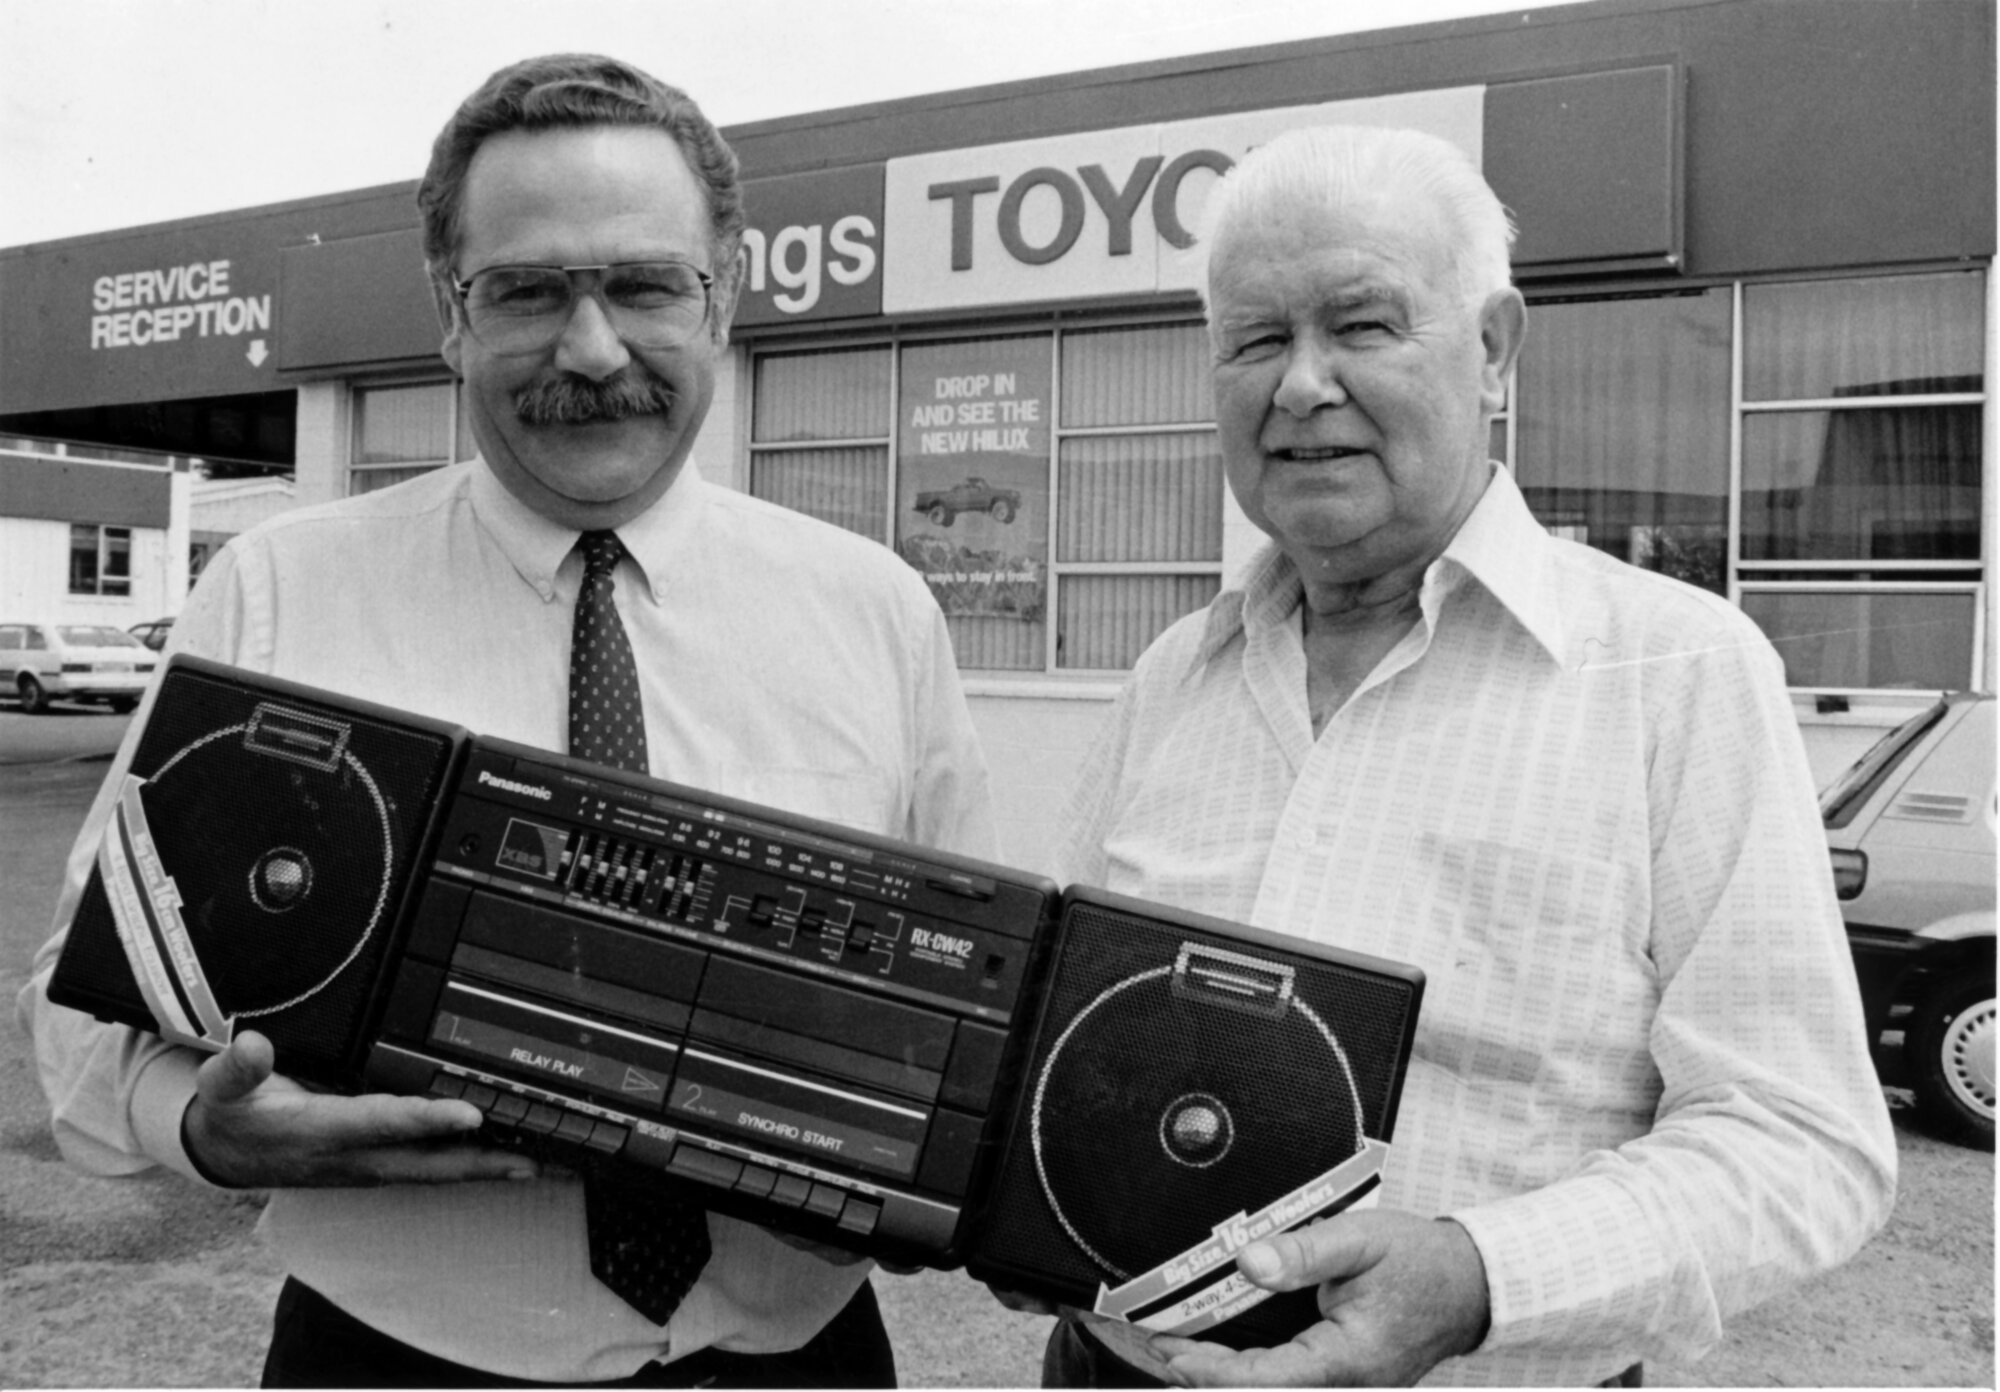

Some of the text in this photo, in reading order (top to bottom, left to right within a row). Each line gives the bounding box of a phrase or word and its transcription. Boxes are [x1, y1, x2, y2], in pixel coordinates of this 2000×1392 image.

[928, 148, 1240, 272] TOYO
[93, 260, 230, 311] SERVICE
[91, 295, 271, 349] RECEPTION
[935, 372, 1016, 399] DROP IN
[912, 399, 1040, 428] AND SEE THE
[921, 427, 1030, 454] NEW HILUX
[478, 770, 552, 801] Panasonic
[133, 832, 154, 858] Big
[798, 853, 812, 864] 104
[152, 882, 176, 910] 16
[159, 907, 178, 930] cm
[168, 927, 200, 988] Woofers
[910, 927, 975, 959] RX-CW42
[510, 1047, 585, 1079] RELAY PLAY
[681, 1083, 702, 1111] 2
[737, 1111, 844, 1151] SYNCHRO START
[1162, 1265, 1191, 1287] Big
[1219, 1223, 1250, 1252] 16
[1250, 1219, 1272, 1240] cm
[1270, 1182, 1335, 1226] Woofers
